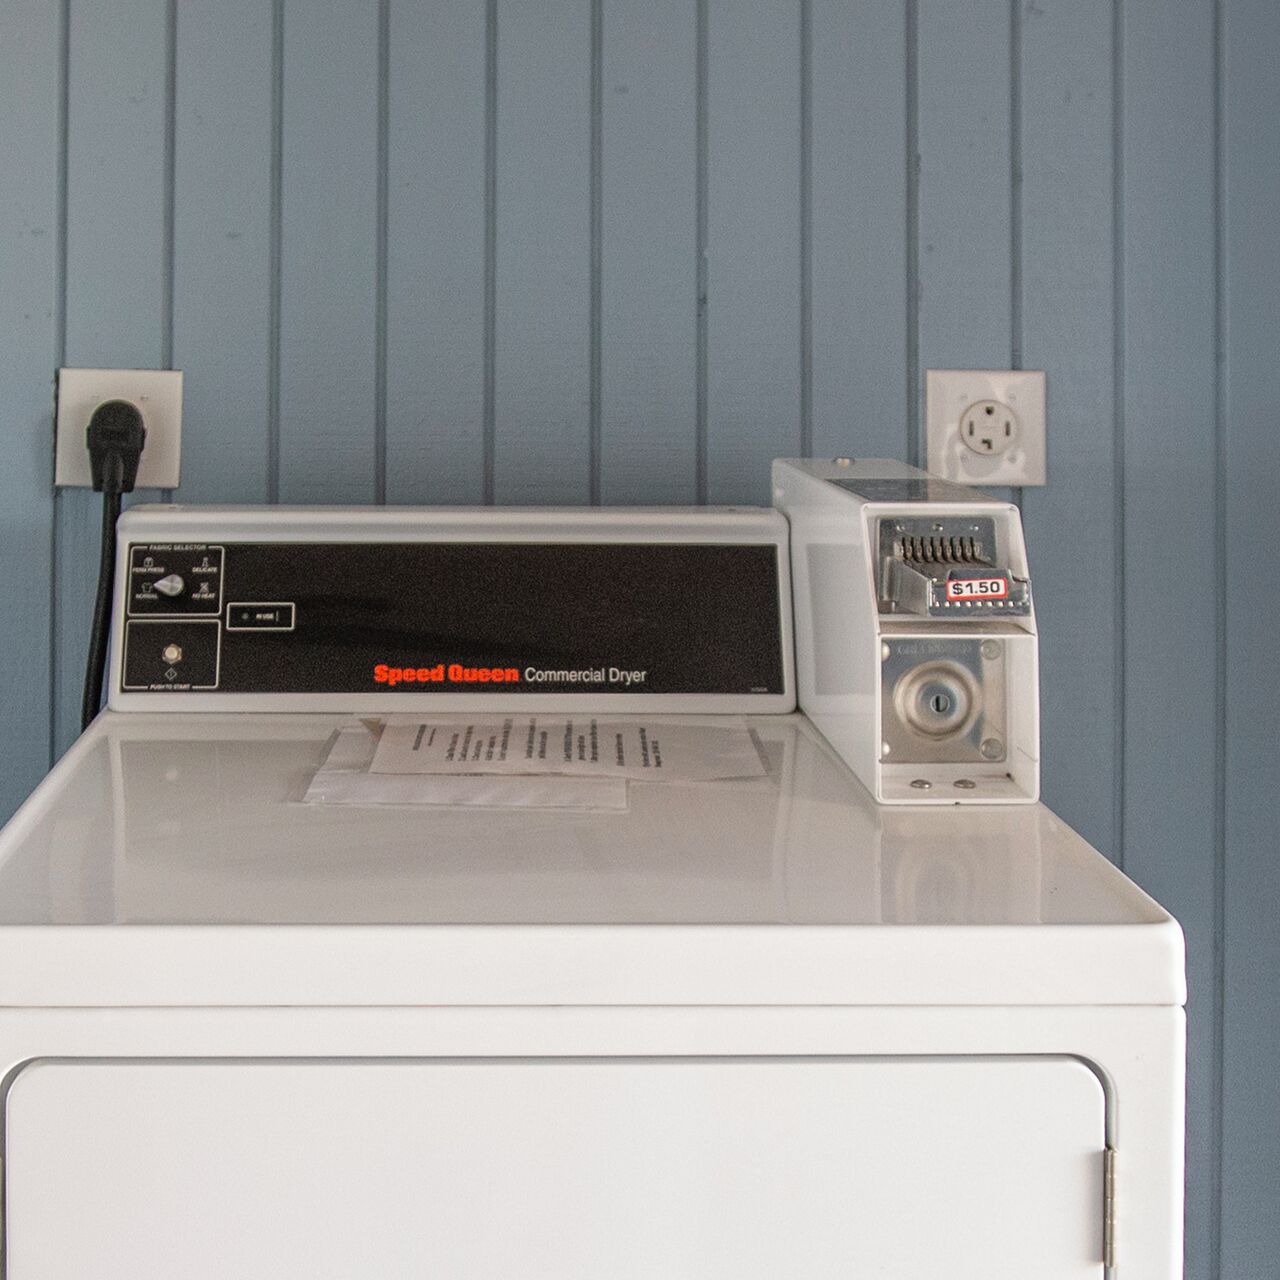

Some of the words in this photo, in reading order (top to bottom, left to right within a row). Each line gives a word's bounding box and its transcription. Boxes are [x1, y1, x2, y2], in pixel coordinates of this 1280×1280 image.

[952, 581, 1001, 596] $1.50
[374, 664, 445, 686] Speed
[448, 664, 520, 682] Queen
[524, 666, 606, 683] Commercial
[608, 667, 647, 685] Dryer
